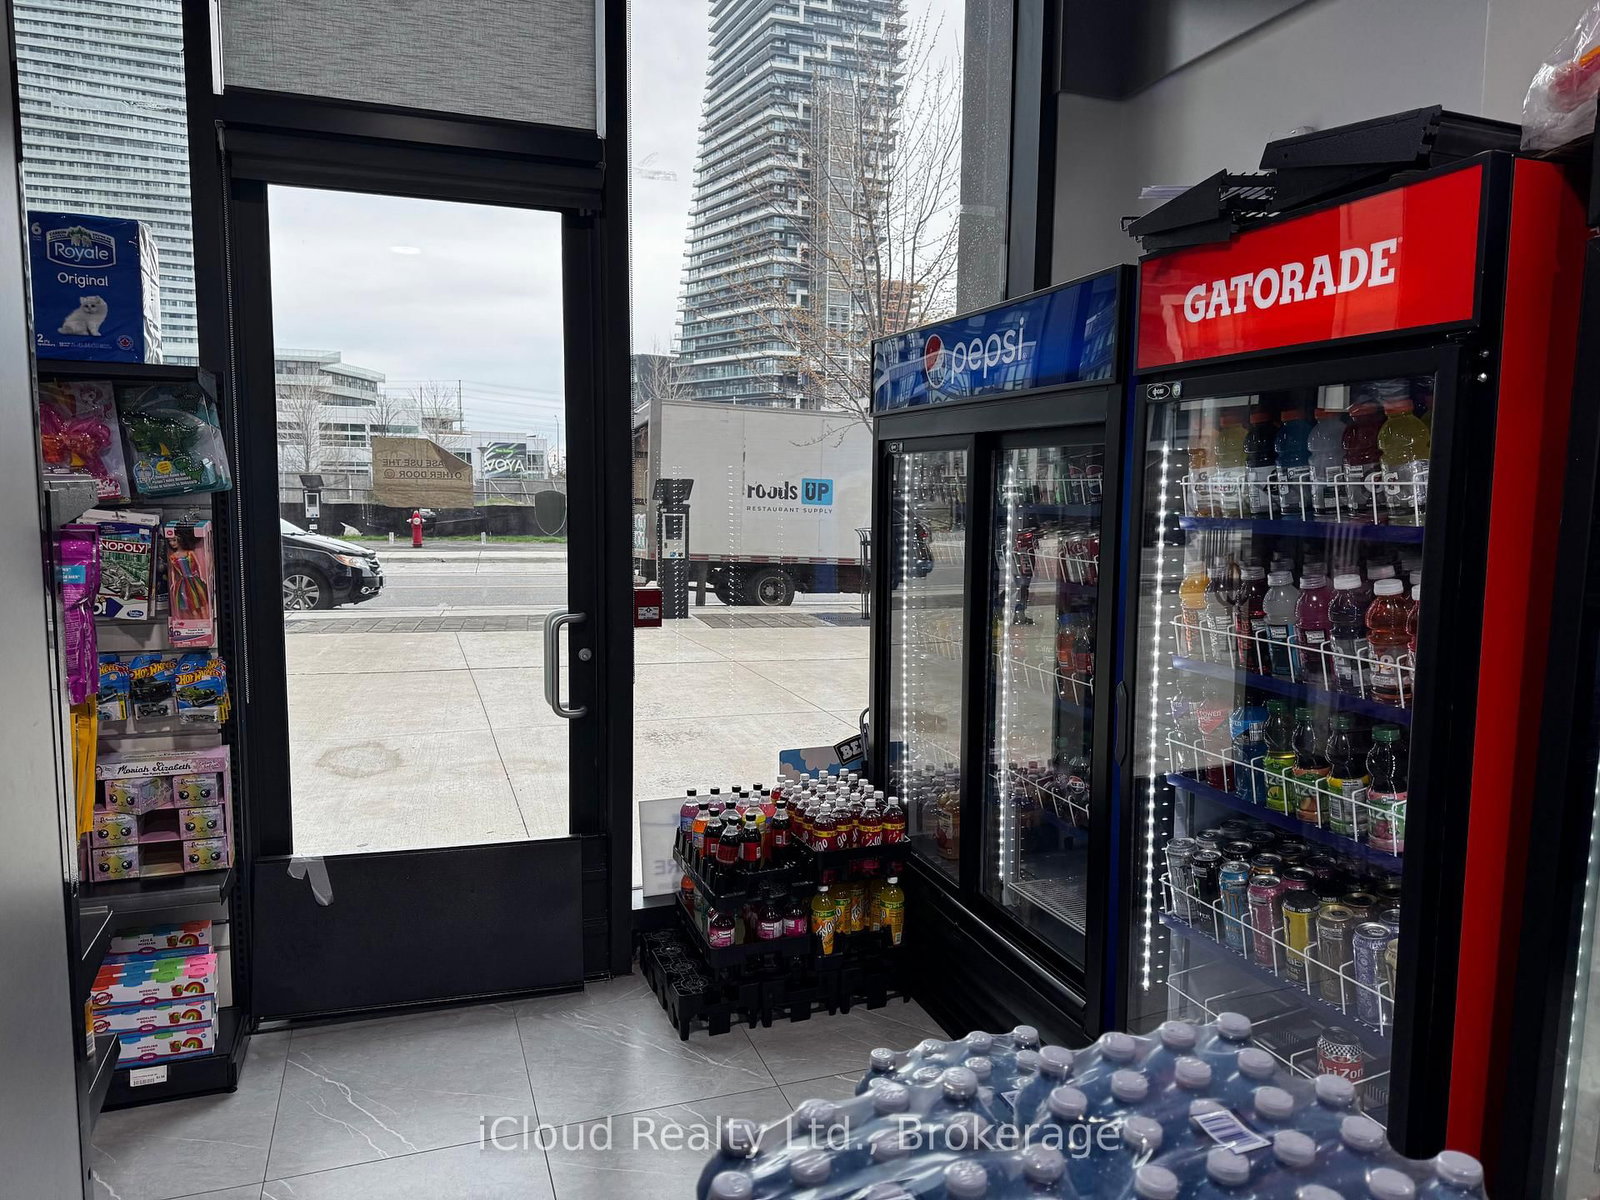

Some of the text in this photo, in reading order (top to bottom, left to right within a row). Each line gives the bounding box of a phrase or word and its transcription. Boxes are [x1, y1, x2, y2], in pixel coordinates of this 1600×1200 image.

[54, 242, 109, 262] Royale
[57, 272, 109, 288] Original
[1183, 238, 1398, 323] GATORADE
[951, 316, 1024, 385] pepsi
[485, 459, 525, 472] VOYA
[805, 482, 830, 501] UP
[101, 541, 145, 553] NOPOLY
